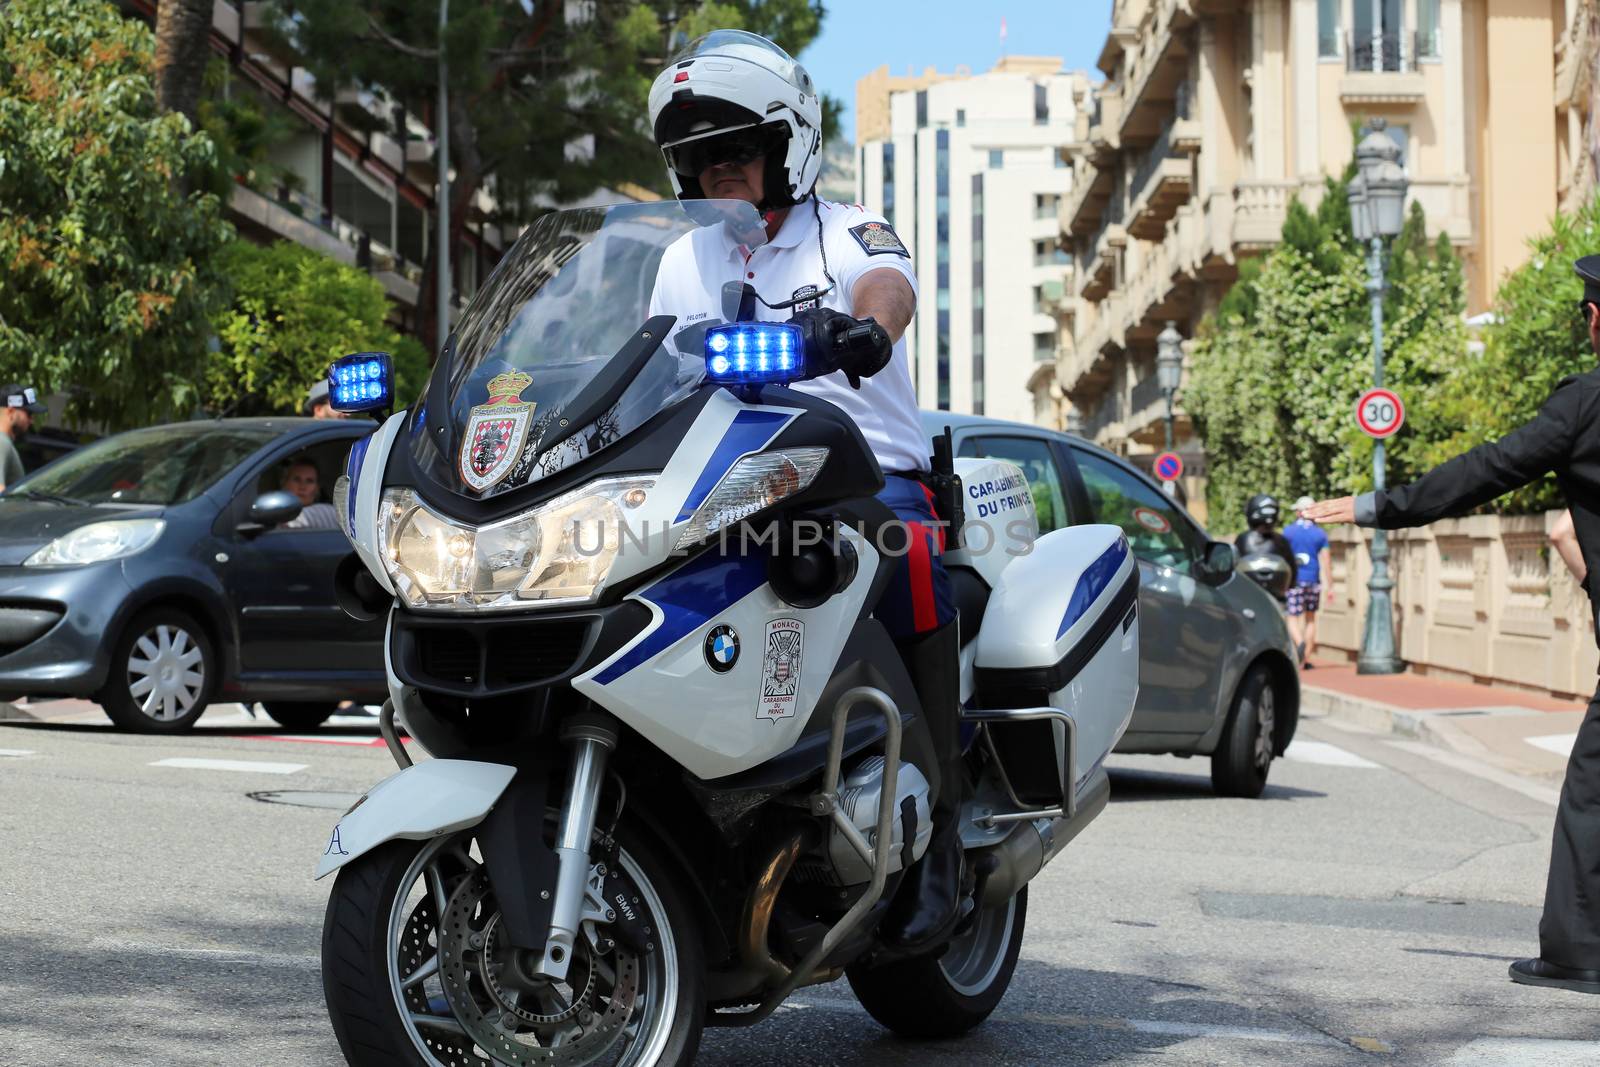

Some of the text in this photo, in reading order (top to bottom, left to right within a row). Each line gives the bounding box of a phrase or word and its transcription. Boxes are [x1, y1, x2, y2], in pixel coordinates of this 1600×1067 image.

[687, 312, 707, 320] PELOTON
[1367, 403, 1394, 422] 30
[977, 491, 1031, 518] DU PRINCE
[772, 621, 800, 630] MONACO
[324, 824, 349, 855] A
[616, 893, 636, 921] BMW
